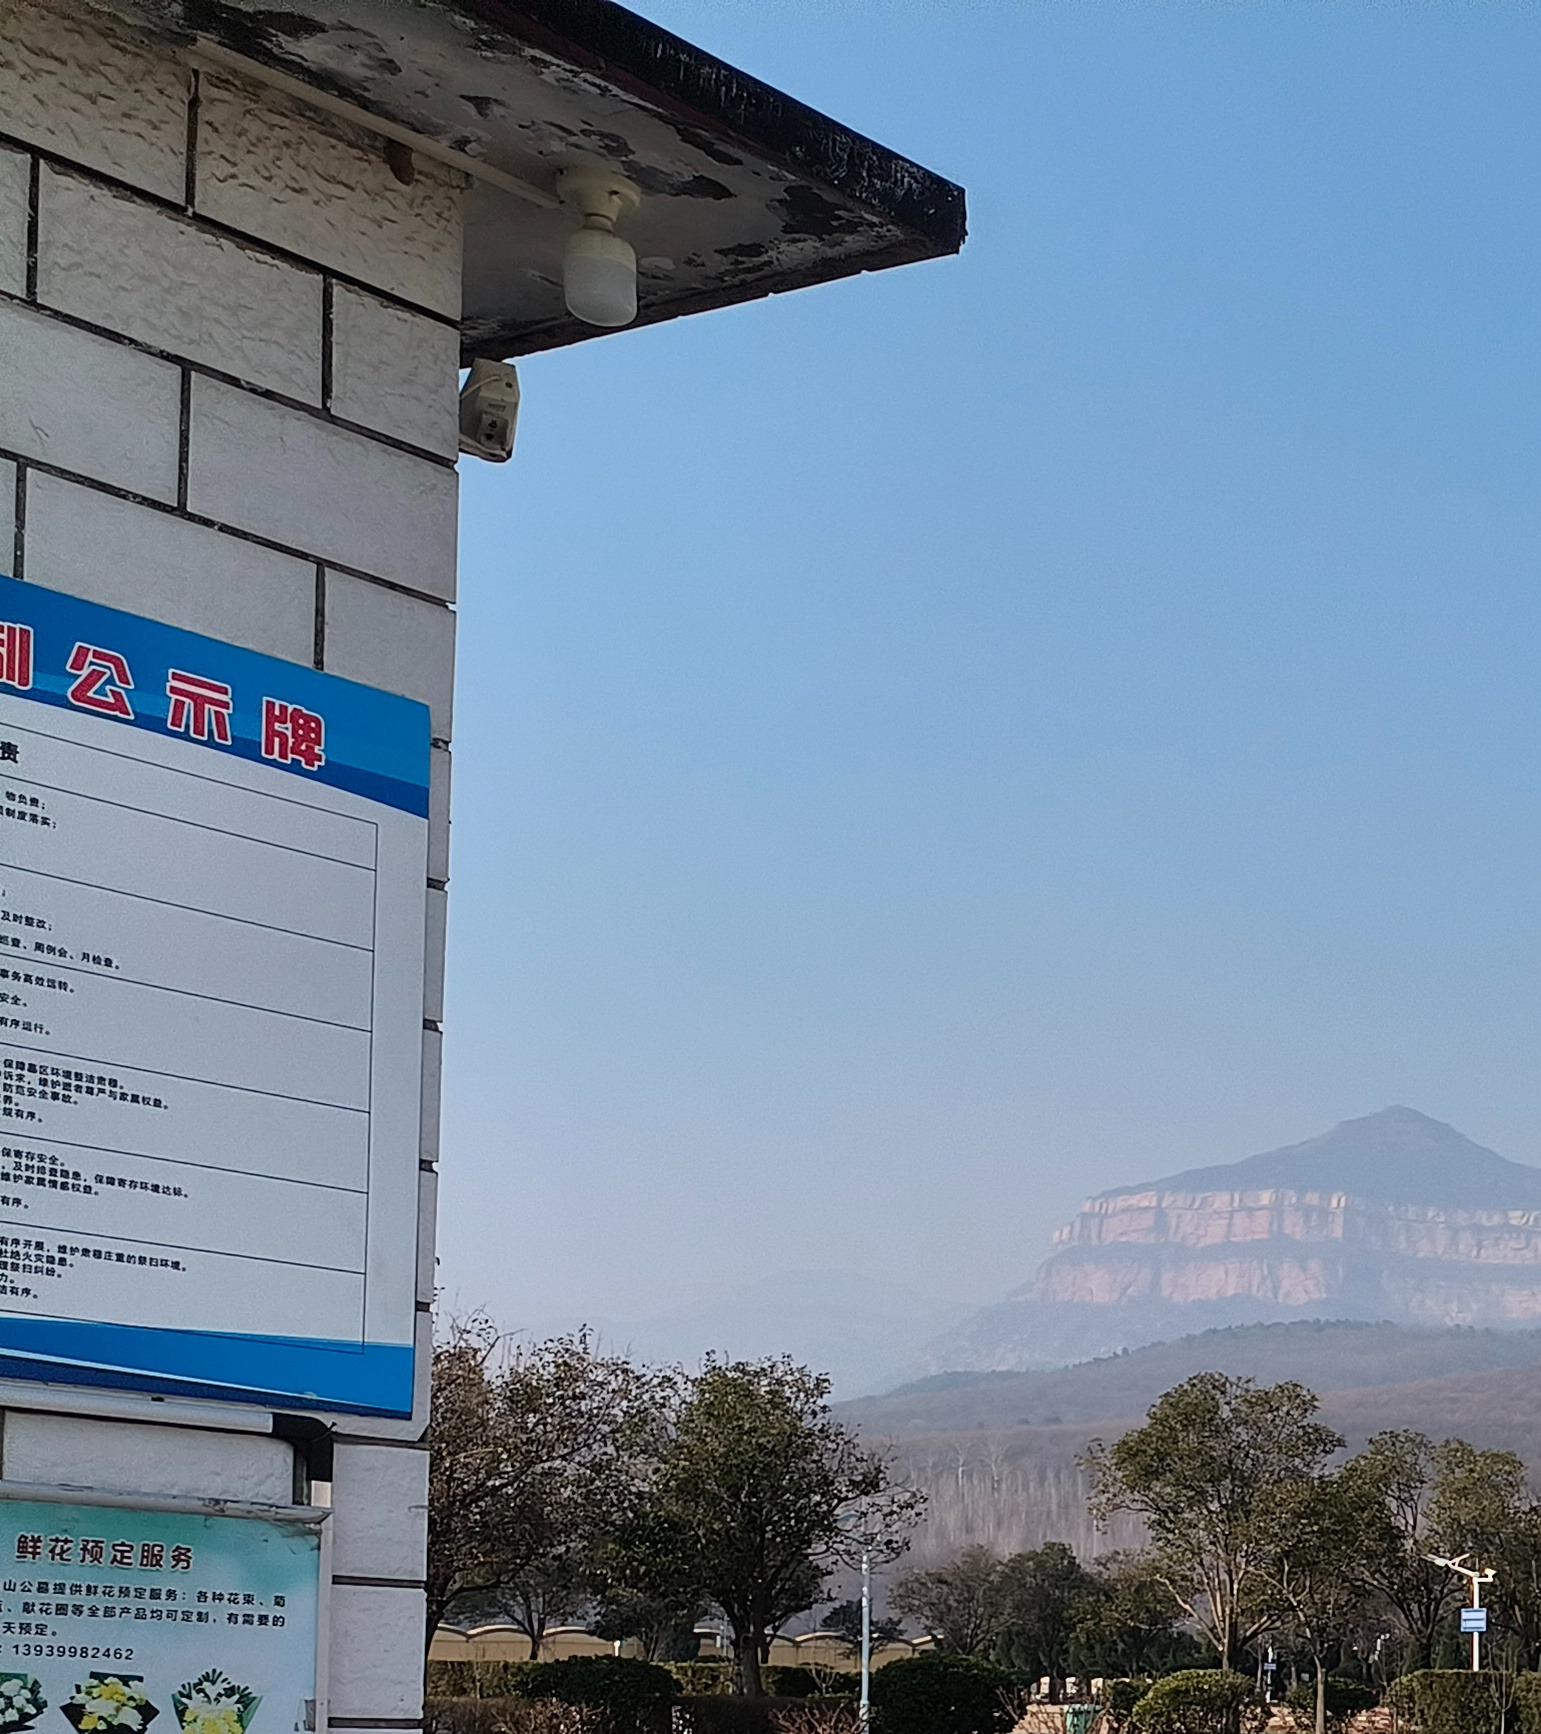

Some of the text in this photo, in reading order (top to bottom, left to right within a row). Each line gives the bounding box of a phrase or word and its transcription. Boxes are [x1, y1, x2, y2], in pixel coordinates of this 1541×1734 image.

[15, 1533, 194, 1570] 鲜花预定服务
[0, 1601, 286, 1628] 、献花圈等全部产品均可定制，有需要的
